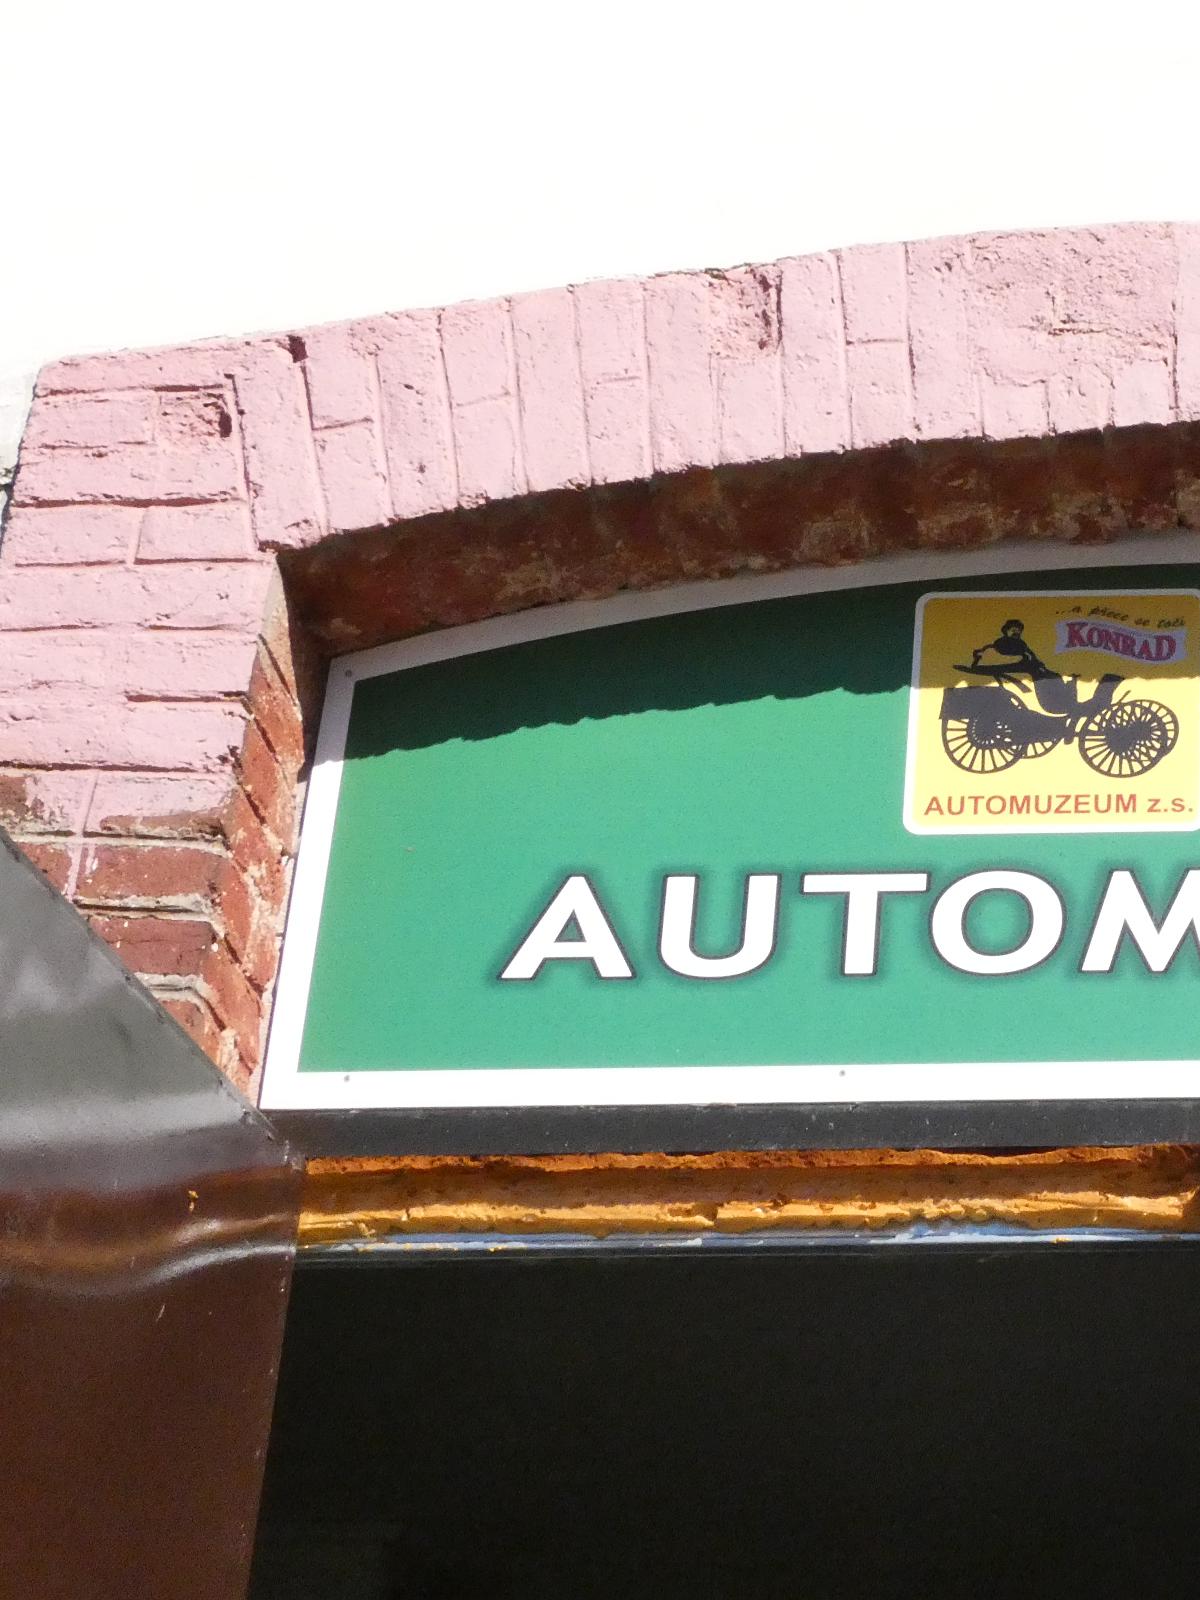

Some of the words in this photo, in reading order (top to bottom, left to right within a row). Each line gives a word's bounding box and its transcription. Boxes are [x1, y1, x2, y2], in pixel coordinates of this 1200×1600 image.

[1066, 621, 1177, 662] KONRAD
[924, 793, 1138, 816] AUTOMUZEUM
[1147, 797, 1194, 814] z.s.
